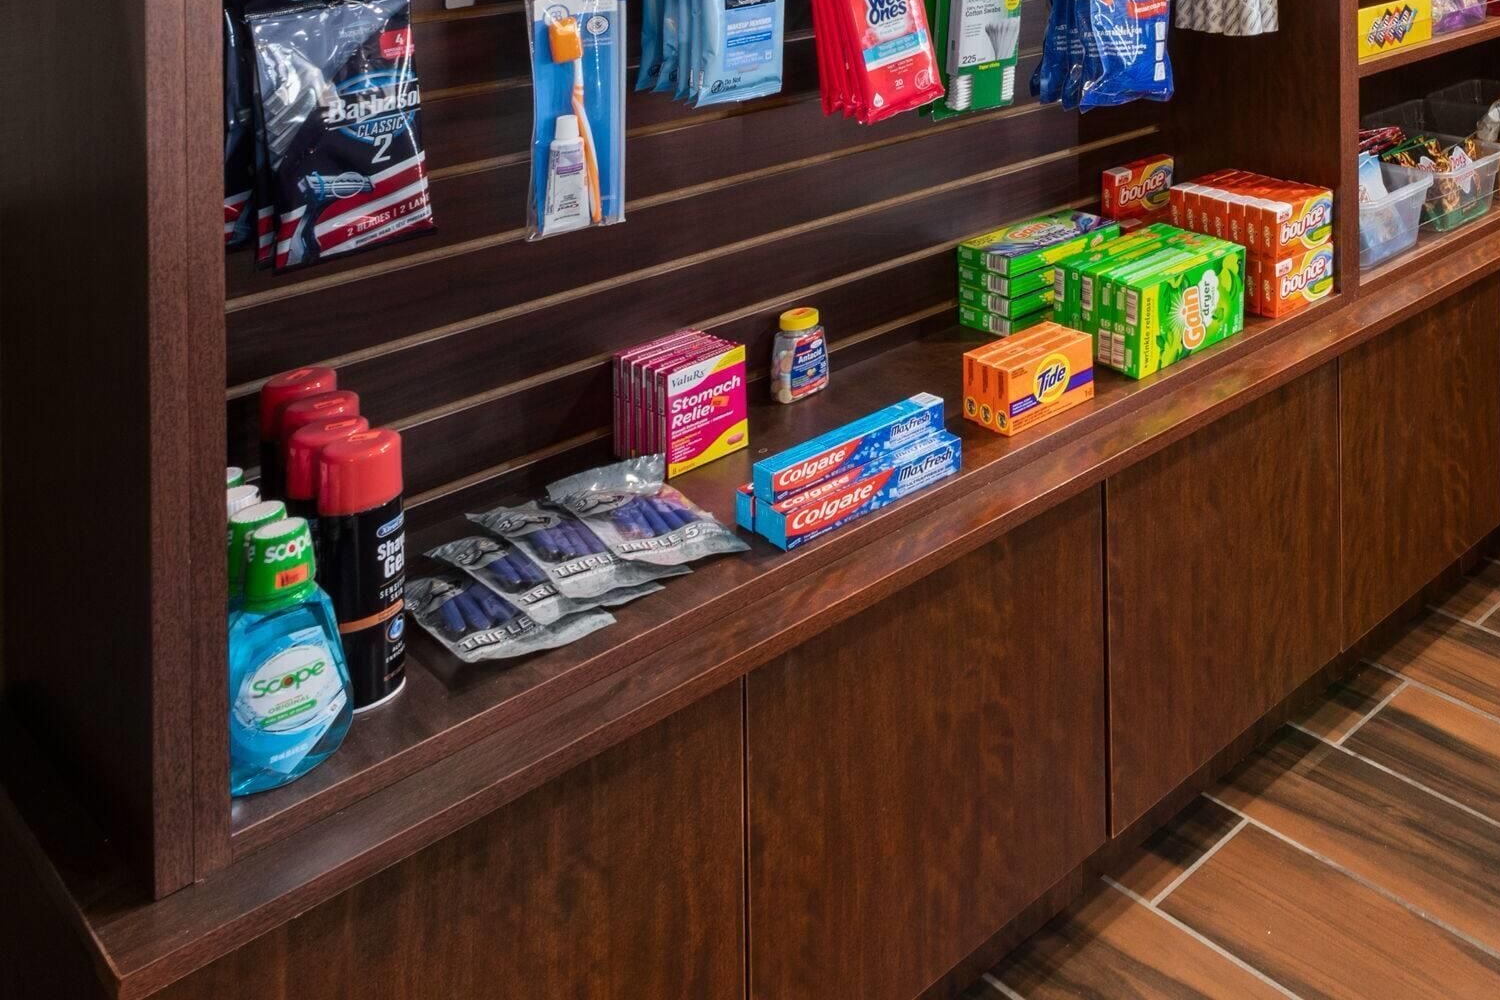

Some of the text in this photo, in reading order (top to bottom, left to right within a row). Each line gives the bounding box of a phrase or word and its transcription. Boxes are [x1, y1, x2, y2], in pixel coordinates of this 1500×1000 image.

[869, 0, 907, 25] Ones
[965, 6, 1002, 18] Cotton Swabs
[396, 34, 404, 45] 4
[962, 55, 977, 65] 225
[894, 78, 904, 87] 20
[329, 84, 421, 123] Barbasol
[357, 115, 405, 137] CLASSIC
[371, 133, 393, 164] 2
[1119, 172, 1166, 206] bounce
[347, 204, 407, 237] 2 BLADES 2
[1280, 205, 1325, 244] bounce
[1280, 257, 1326, 299] bounce
[1203, 280, 1211, 316] dryer
[1182, 285, 1206, 350] Gain
[798, 347, 823, 365] Antacid
[670, 368, 705, 388] ValuRx
[671, 375, 741, 414] Stomach
[1036, 365, 1067, 399] Tide
[889, 412, 930, 439] MaxFresh
[778, 448, 847, 488] Colgate
[899, 446, 953, 482] MaxFresh
[791, 481, 875, 531] Colgate
[618, 524, 699, 553] TRIPLE 5
[553, 554, 616, 578] TRIPLE
[459, 617, 534, 652] TRIPLE
